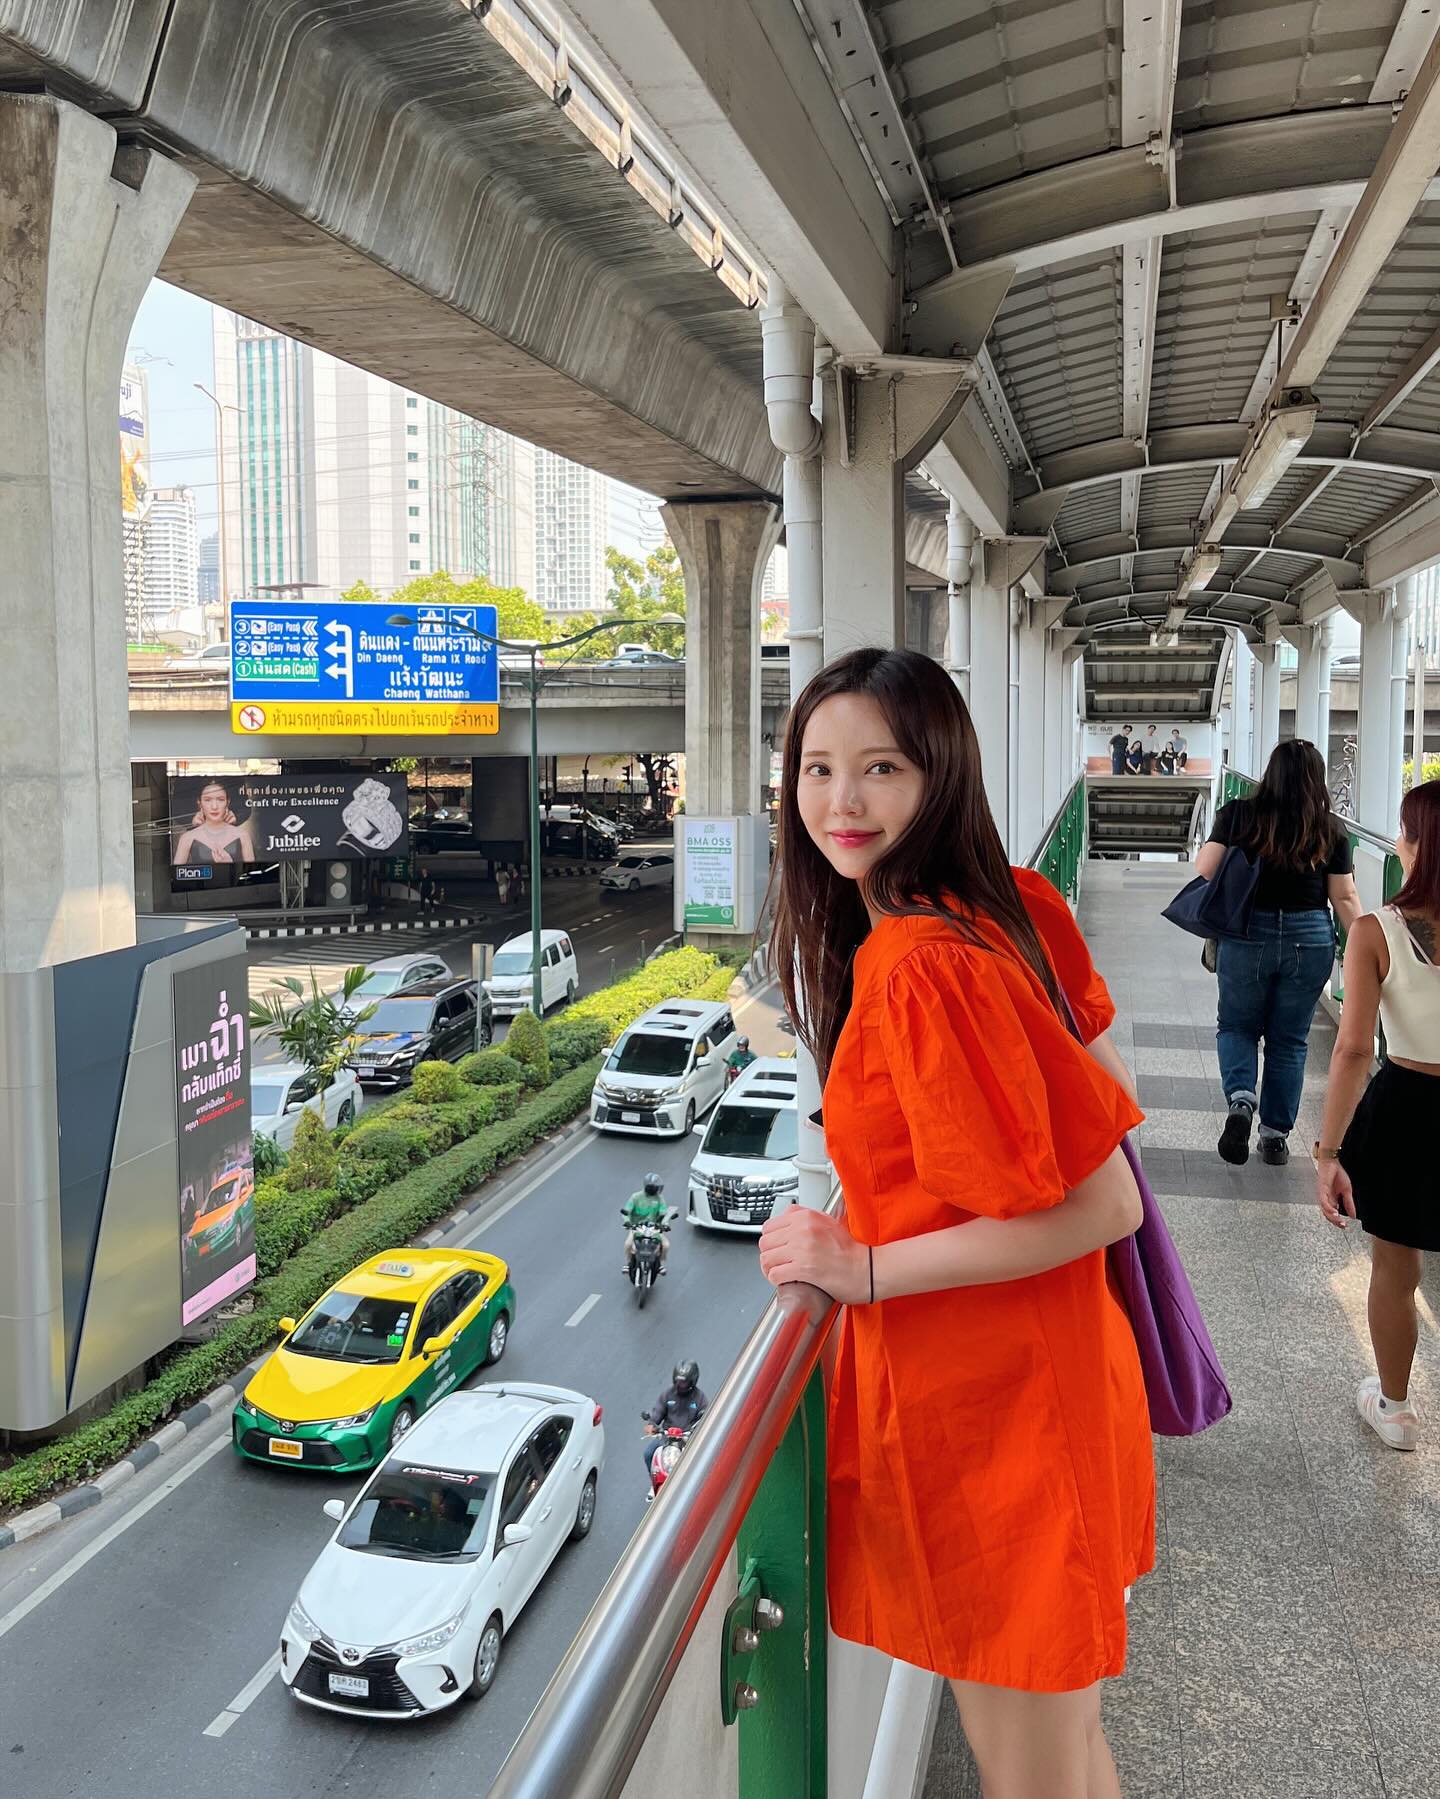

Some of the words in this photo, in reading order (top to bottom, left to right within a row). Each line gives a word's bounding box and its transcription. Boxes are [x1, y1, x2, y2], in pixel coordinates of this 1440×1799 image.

[119, 383, 132, 400] uji
[359, 630, 400, 650] ดินแดง
[357, 652, 371, 663] Din
[376, 653, 403, 665] Daeng
[422, 653, 447, 664] Rama
[451, 654, 460, 664] IX
[465, 654, 487, 664] Road
[390, 665, 464, 686] แจ้งวัฒนะ
[384, 688, 420, 700] Chaeng
[425, 688, 470, 699] Watthana
[245, 799, 269, 807] Craft
[272, 798, 288, 807] For
[291, 798, 340, 807] Excellence
[266, 834, 321, 851] Jubilee
[687, 837, 709, 846] BMA
[711, 837, 732, 847] OSS
